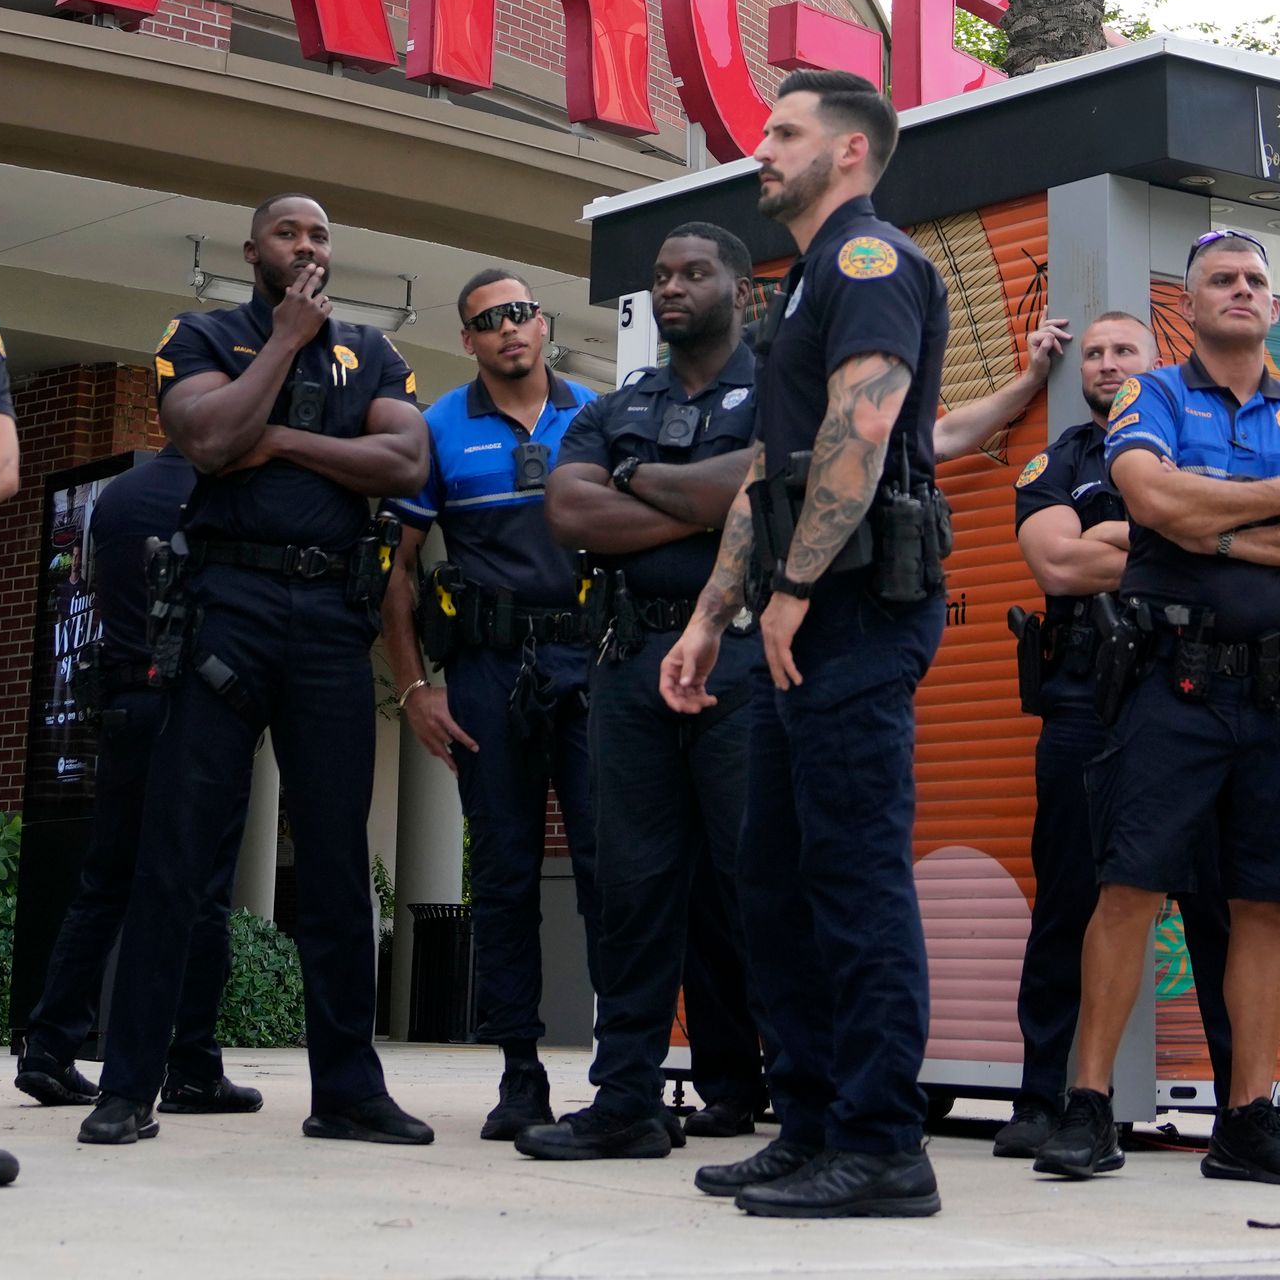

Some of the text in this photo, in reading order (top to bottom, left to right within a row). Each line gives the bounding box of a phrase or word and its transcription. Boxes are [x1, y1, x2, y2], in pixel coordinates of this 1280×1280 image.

[621, 298, 633, 328] 5
[464, 442, 503, 454] HERNANDEZ
[70, 590, 96, 615] time
[54, 608, 105, 657] WEL
